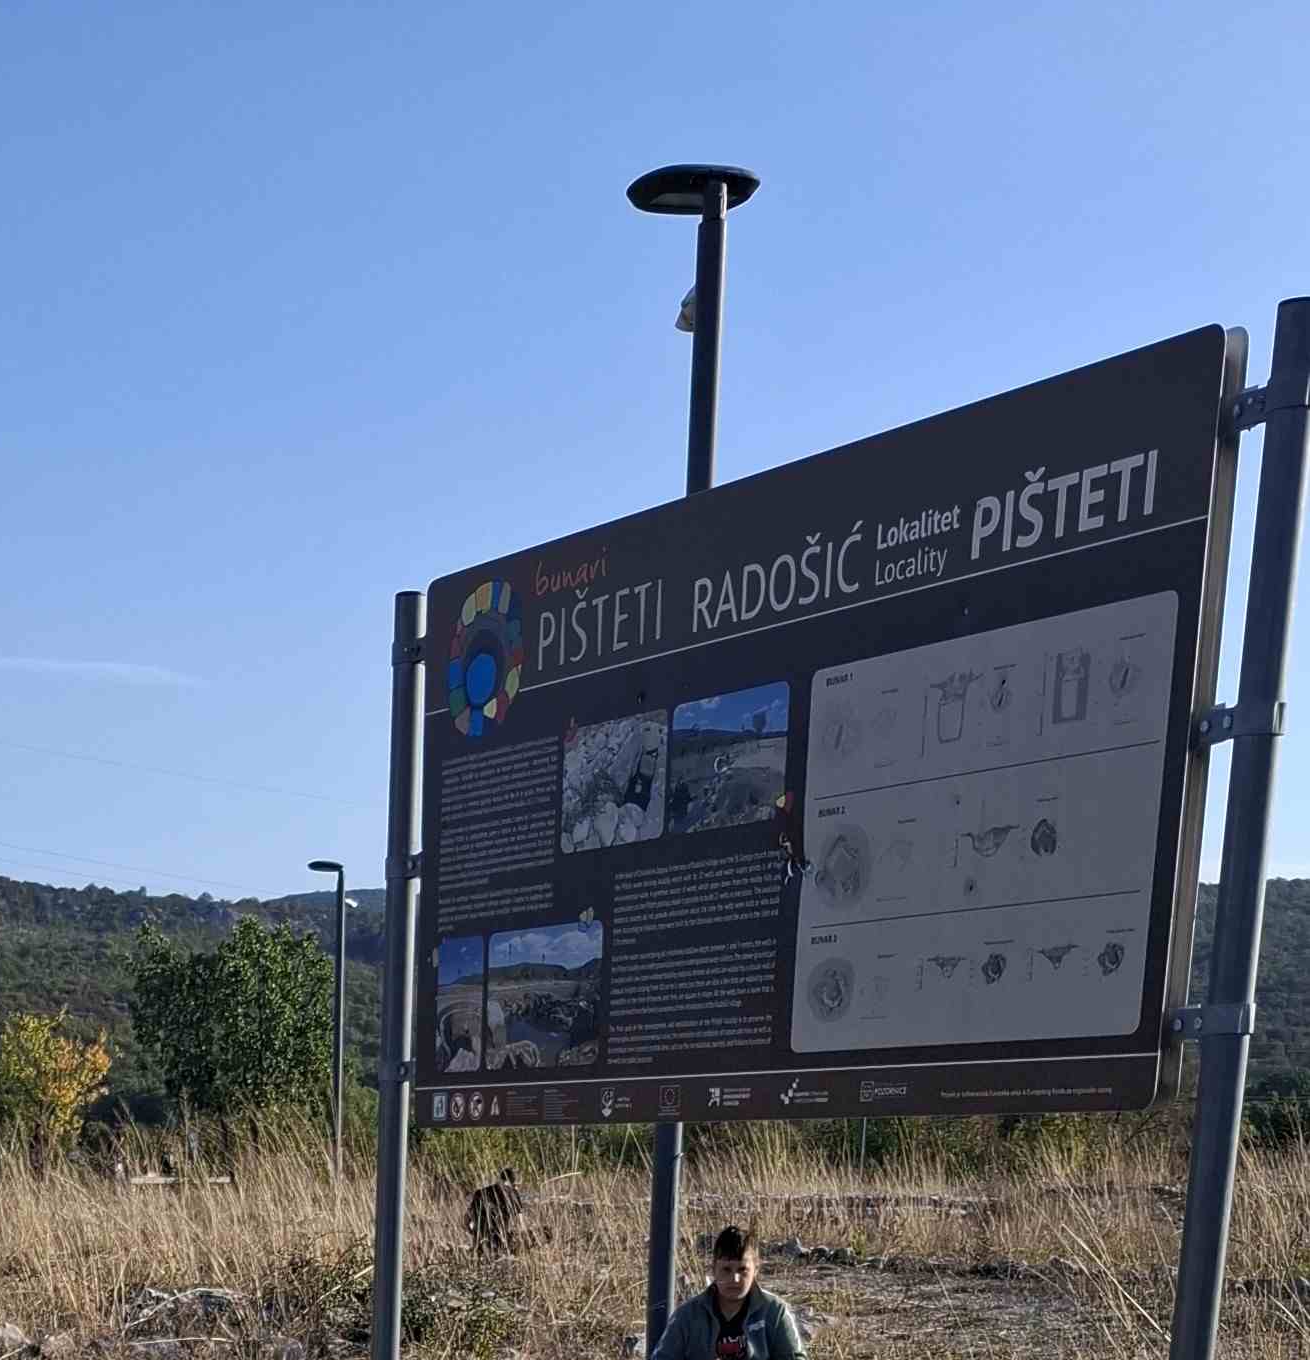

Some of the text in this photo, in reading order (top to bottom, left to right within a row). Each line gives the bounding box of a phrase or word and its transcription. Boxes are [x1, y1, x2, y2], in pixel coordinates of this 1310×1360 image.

[876, 505, 962, 551] Lokalitet
[971, 448, 1158, 560] PIŠTETI
[532, 546, 609, 597] bunari
[692, 519, 864, 633] RADOŠIĆ
[874, 546, 948, 587] Locality
[537, 578, 663, 672] PIŠTETI
